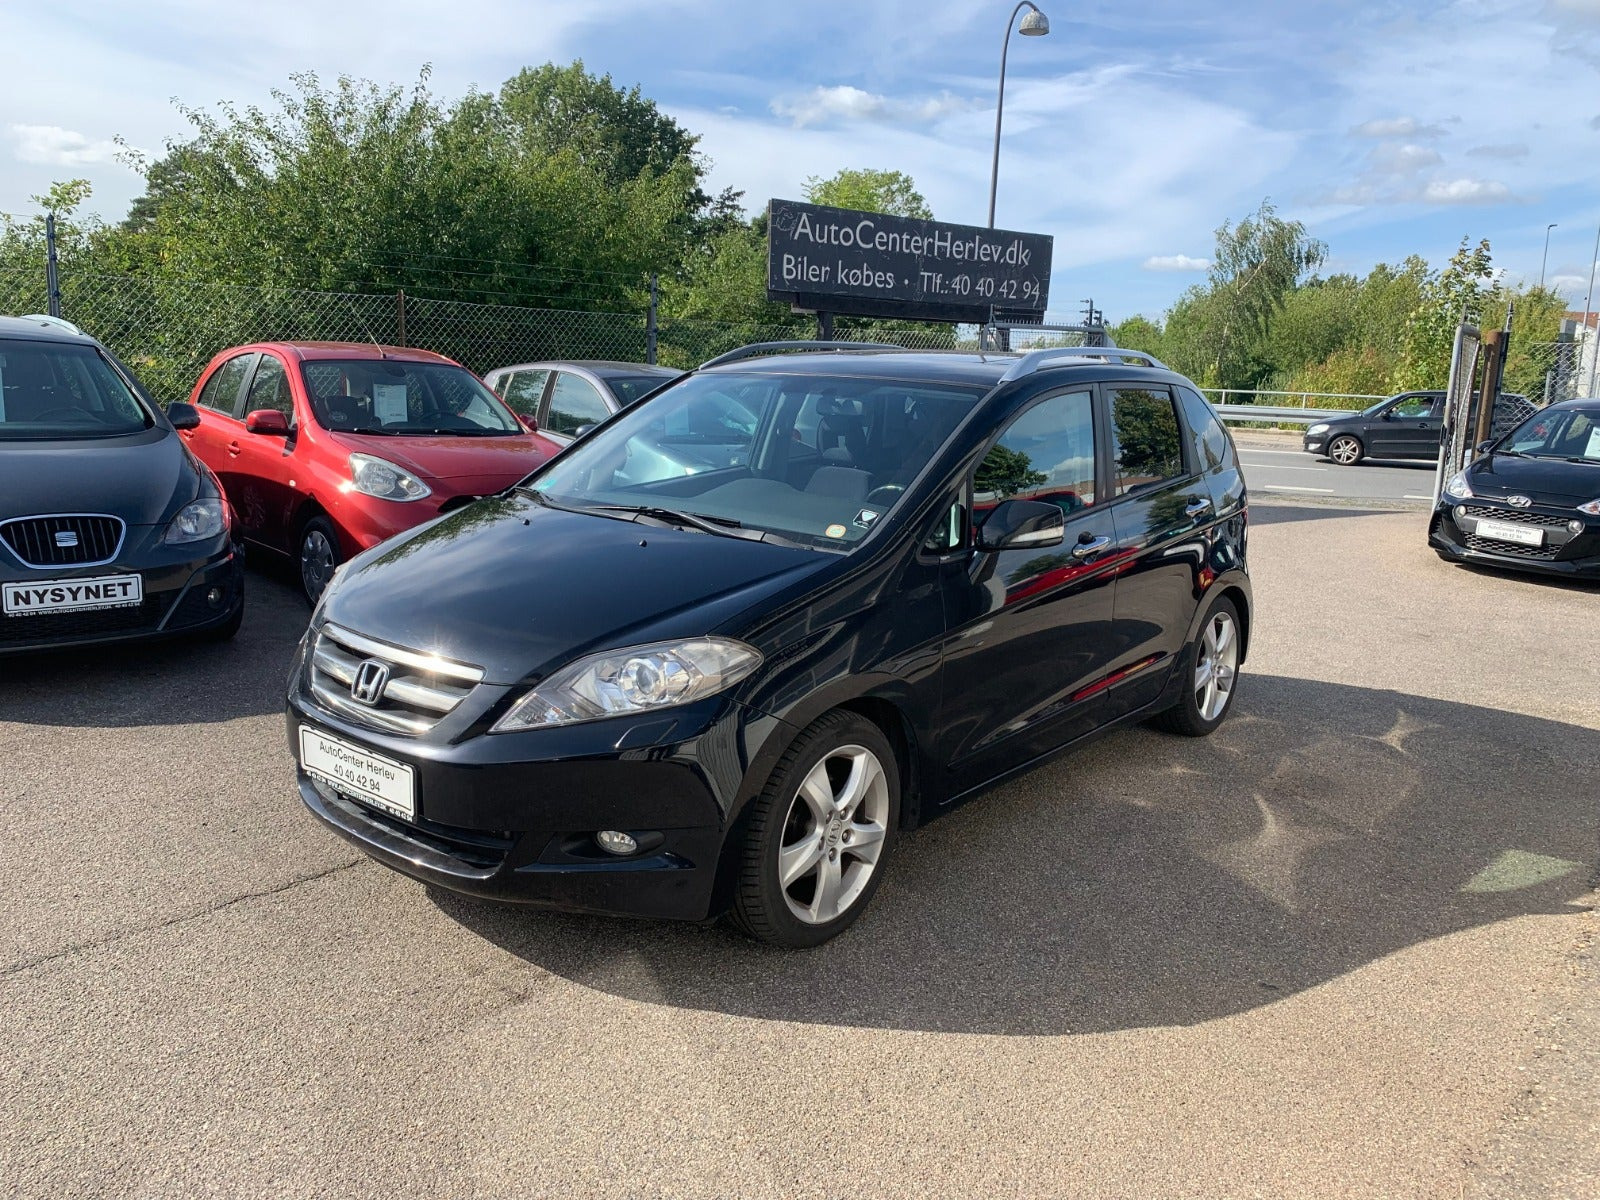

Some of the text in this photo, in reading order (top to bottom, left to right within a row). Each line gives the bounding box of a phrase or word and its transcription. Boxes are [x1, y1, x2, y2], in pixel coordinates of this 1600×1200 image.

[793, 212, 1030, 267] AutoCenterHerlev.dk
[782, 254, 830, 283] Biler
[838, 260, 895, 289] købes
[975, 277, 995, 298] 40
[999, 280, 1017, 300] 42
[1023, 281, 1040, 302] 94
[13, 582, 132, 606] NYSYNET
[319, 741, 395, 781] AutoCenter Herlev
[333, 763, 381, 793] 40 40 42 94
